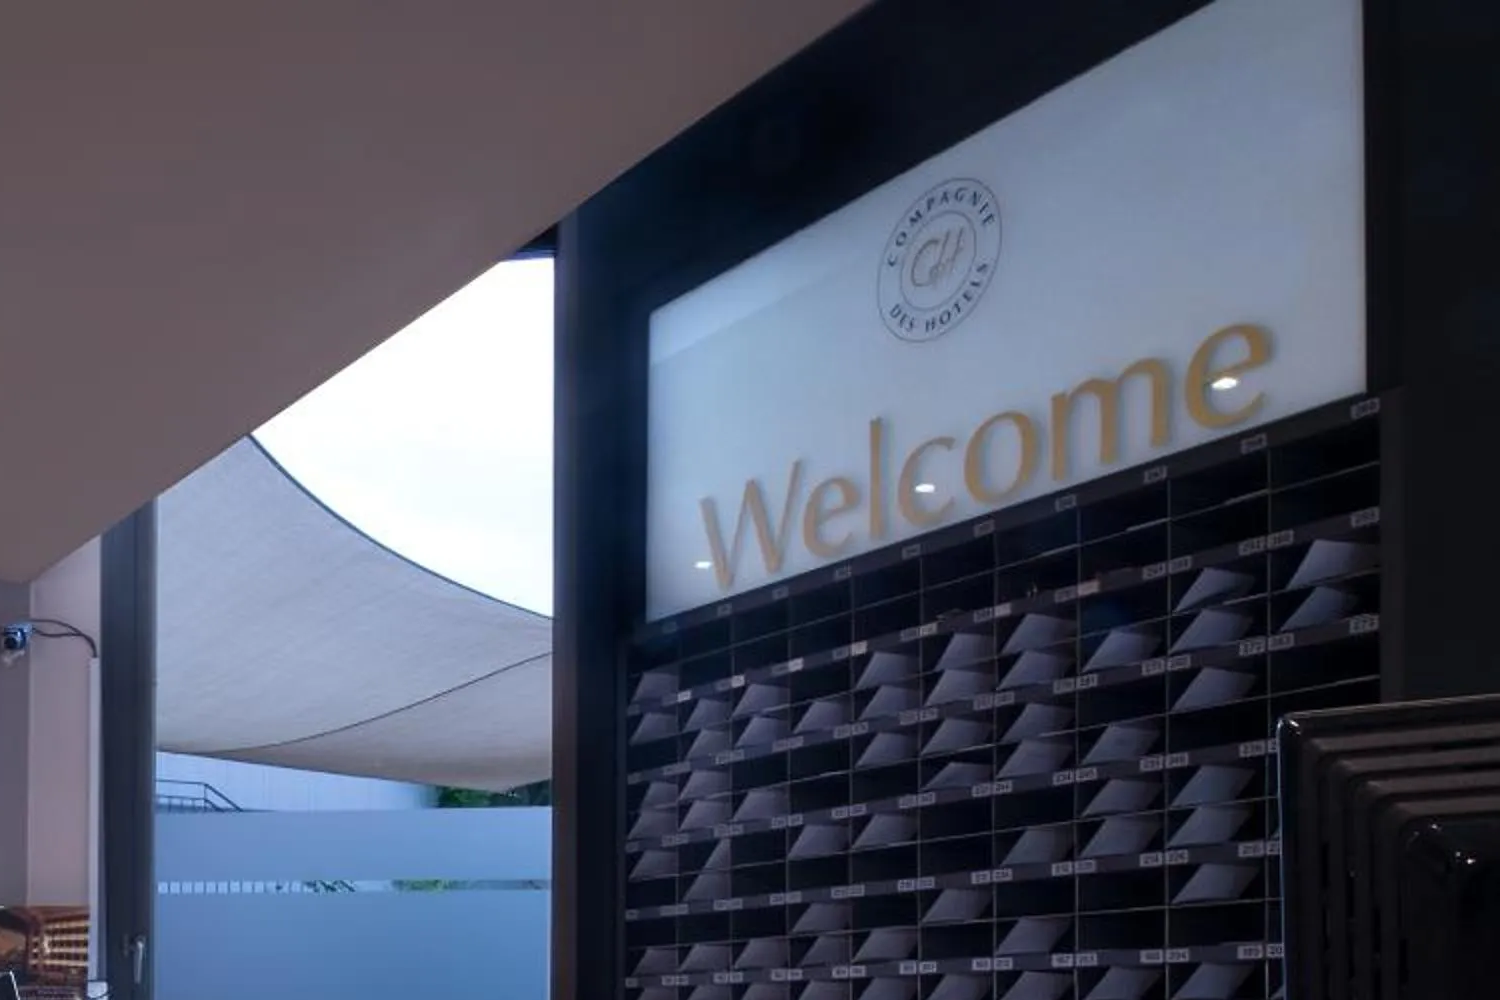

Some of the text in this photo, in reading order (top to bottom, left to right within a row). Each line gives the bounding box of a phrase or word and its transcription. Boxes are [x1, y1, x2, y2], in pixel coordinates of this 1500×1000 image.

[886, 187, 996, 268] COMPAGNIE
[889, 262, 989, 333] DES HOTELS
[701, 321, 1274, 592] Welcome
